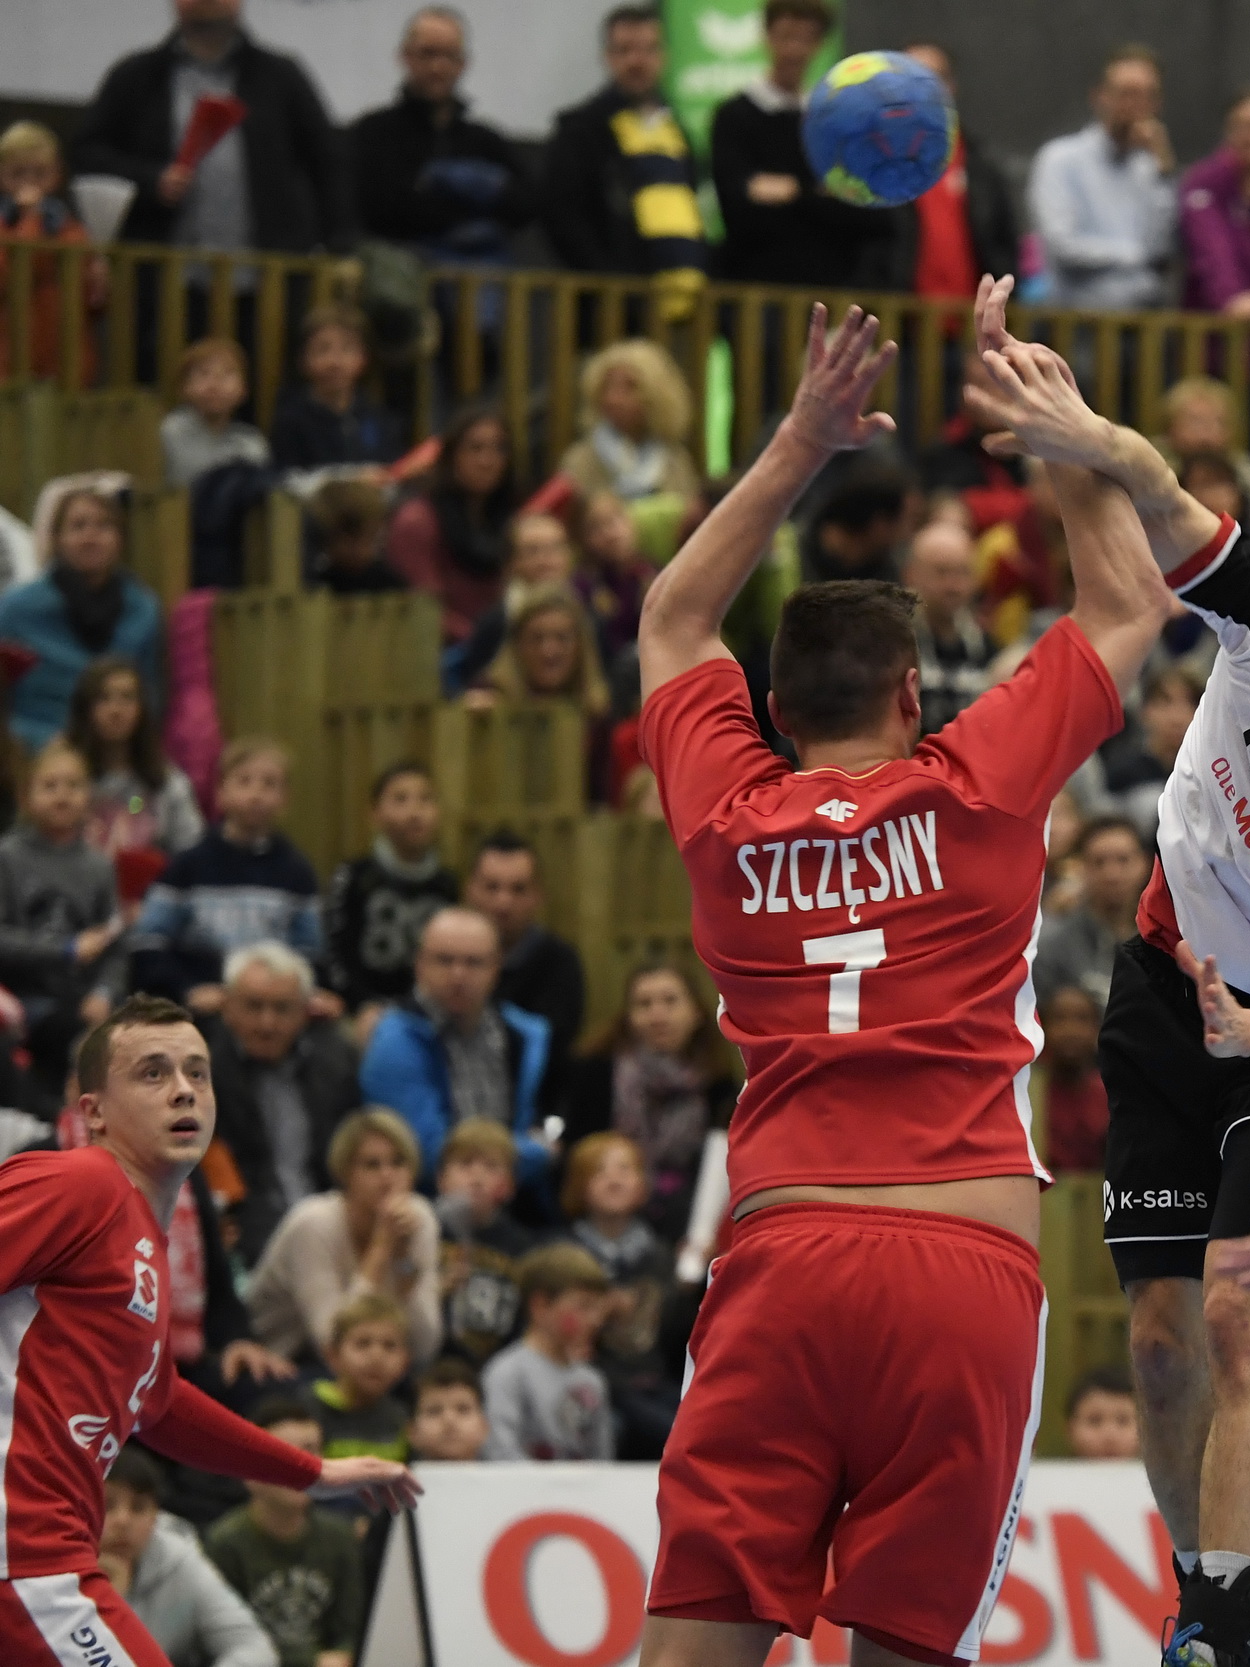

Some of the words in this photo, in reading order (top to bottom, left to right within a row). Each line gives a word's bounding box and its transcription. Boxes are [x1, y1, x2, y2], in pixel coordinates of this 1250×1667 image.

[815, 798, 859, 823] 4F
[737, 810, 944, 925] SZCZĘSNY
[802, 928, 887, 1035] 7
